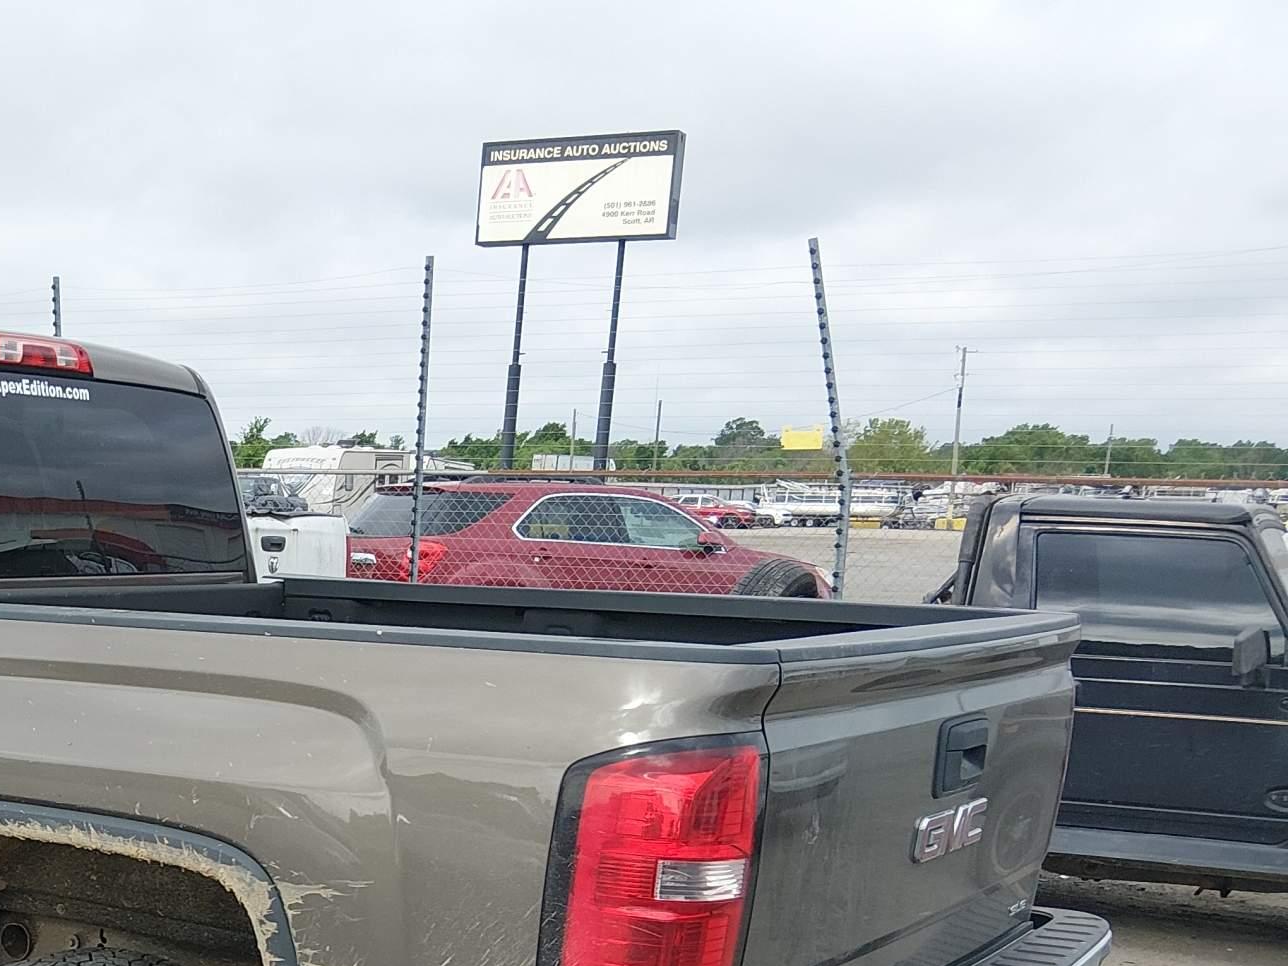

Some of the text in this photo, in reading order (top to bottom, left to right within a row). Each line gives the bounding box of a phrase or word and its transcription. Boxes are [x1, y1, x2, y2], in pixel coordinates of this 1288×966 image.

[490, 139, 668, 162] INSURANCE AUTO AUCTIONS
[637, 209, 656, 217] Road
[913, 797, 988, 863] GMC
